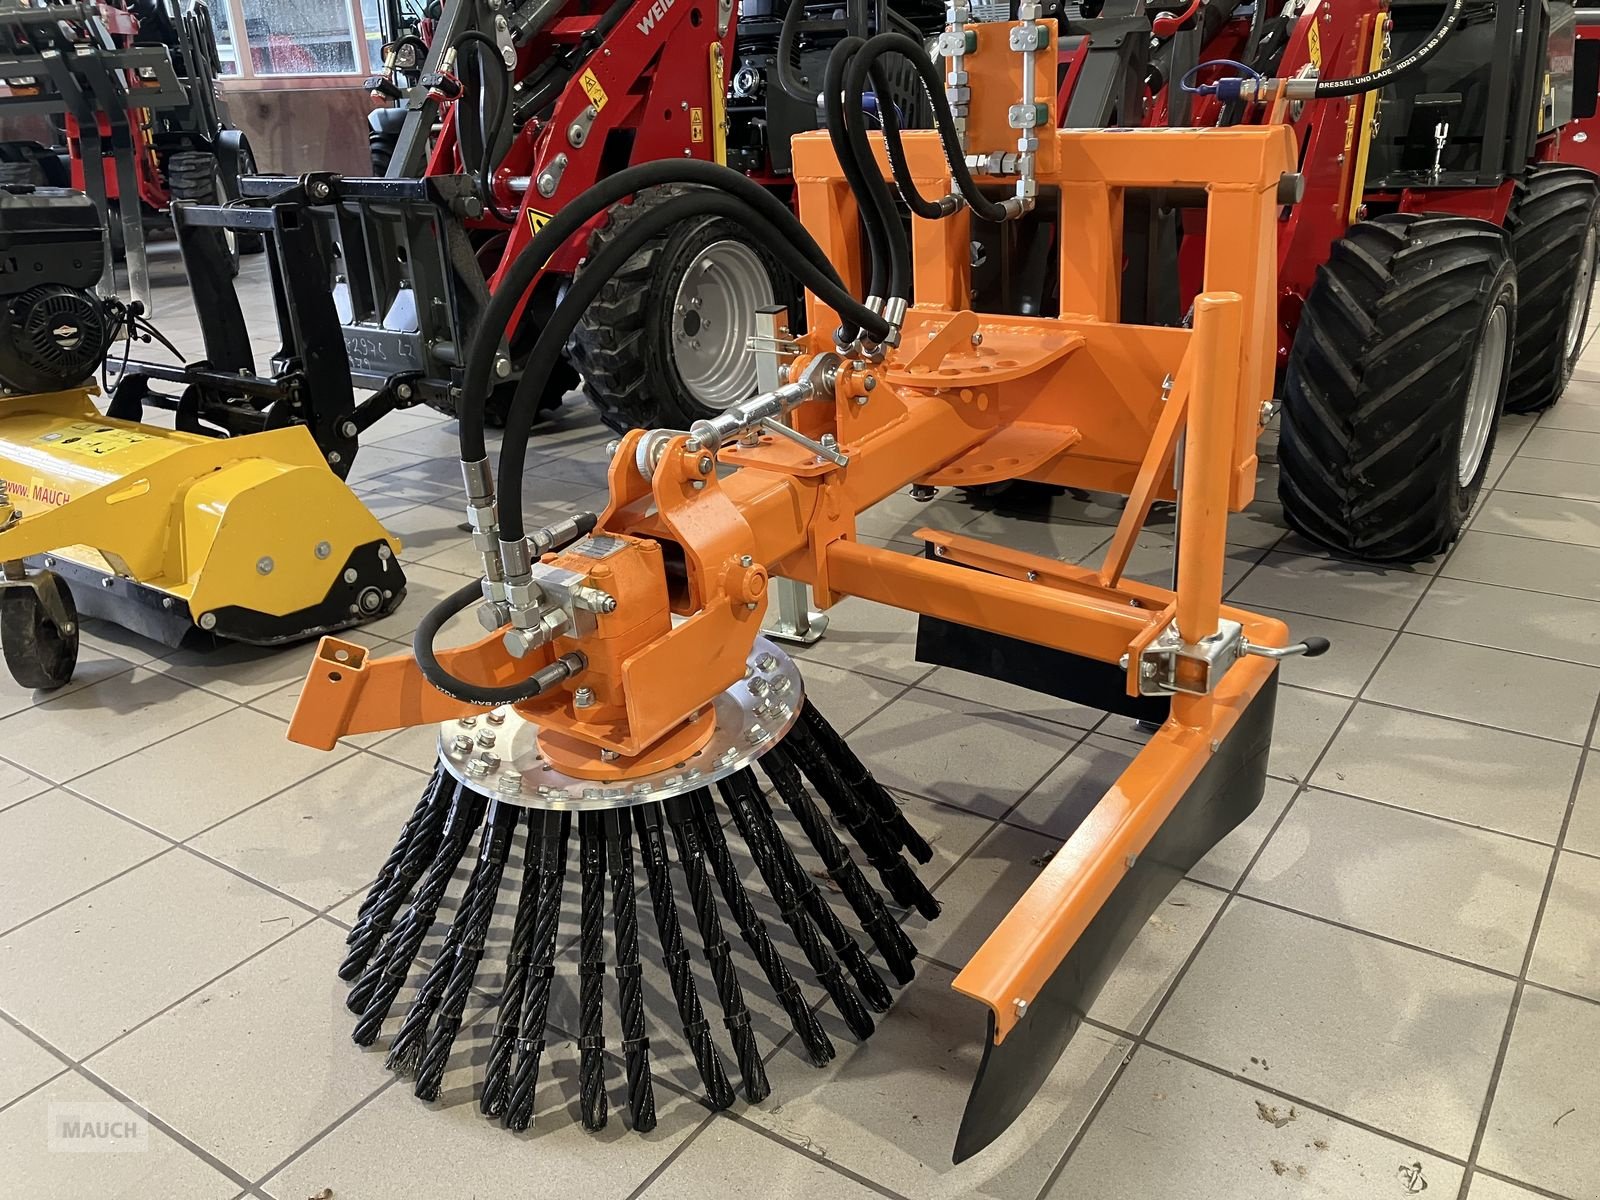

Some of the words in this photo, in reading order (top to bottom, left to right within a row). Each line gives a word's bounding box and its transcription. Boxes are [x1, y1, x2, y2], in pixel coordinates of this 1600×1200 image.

[1318, 80, 1354, 89] BRESSEL
[1355, 75, 1372, 85] UND
[1373, 69, 1392, 80] LADE
[1396, 55, 1417, 70] HD213
[1418, 46, 1430, 56] EN
[32, 484, 71, 506] MAUCH
